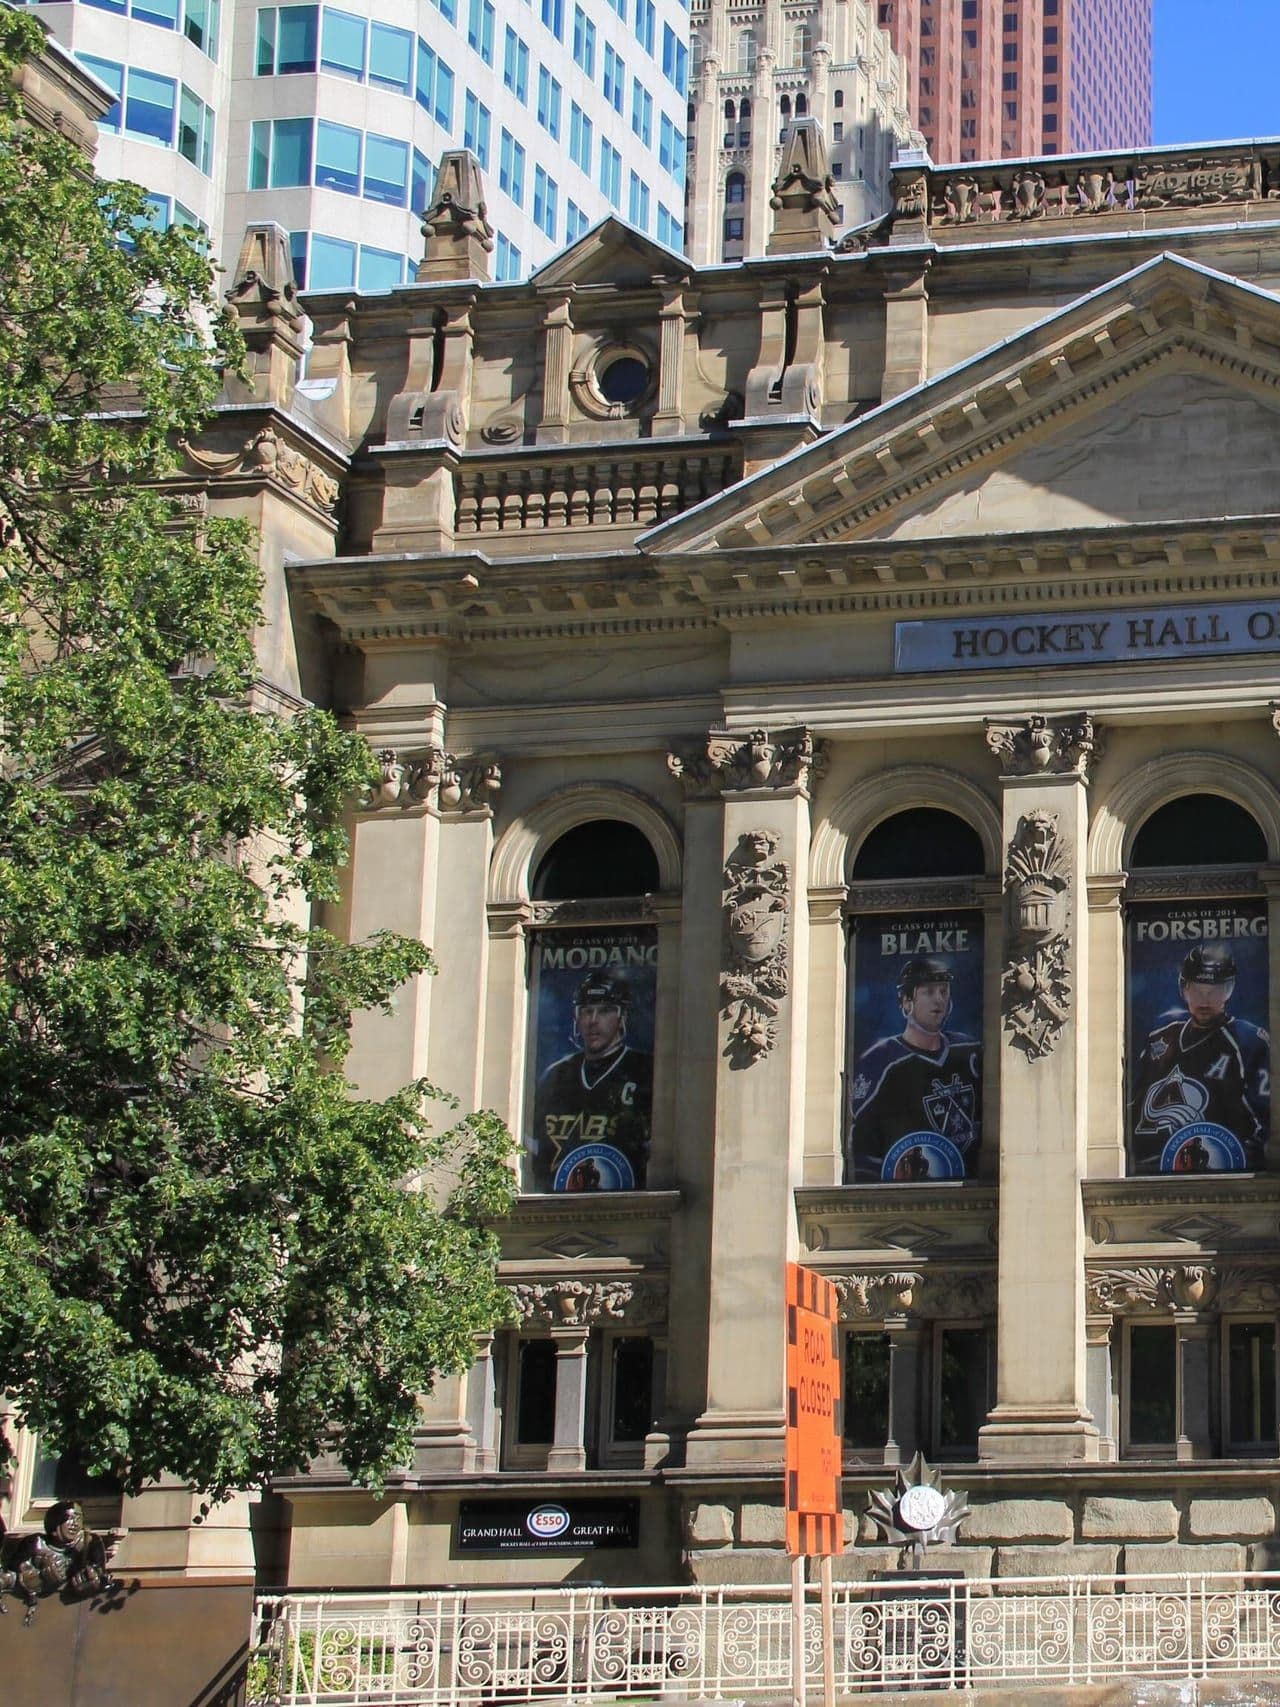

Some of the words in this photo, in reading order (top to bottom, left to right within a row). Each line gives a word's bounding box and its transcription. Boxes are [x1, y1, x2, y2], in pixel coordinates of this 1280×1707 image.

[1189, 171, 1239, 187] 1885
[951, 621, 1111, 658] HOCKEY
[1126, 614, 1230, 648] HALL
[1167, 910, 1198, 919] CLASS
[1200, 909, 1212, 918] OF
[1216, 909, 1237, 917] 2014
[891, 922, 920, 931] CLASS
[923, 922, 935, 930] OF
[1136, 916, 1269, 941] FORSBERG
[881, 929, 969, 956] BLAKE
[1203, 1053, 1231, 1080] A
[621, 1081, 637, 1105] C
[804, 1327, 826, 1367] ROAD
[800, 1375, 832, 1417] CLOSED
[463, 1527, 498, 1537] GRAND
[499, 1527, 522, 1537] HALL
[573, 1526, 604, 1536] GREAT
